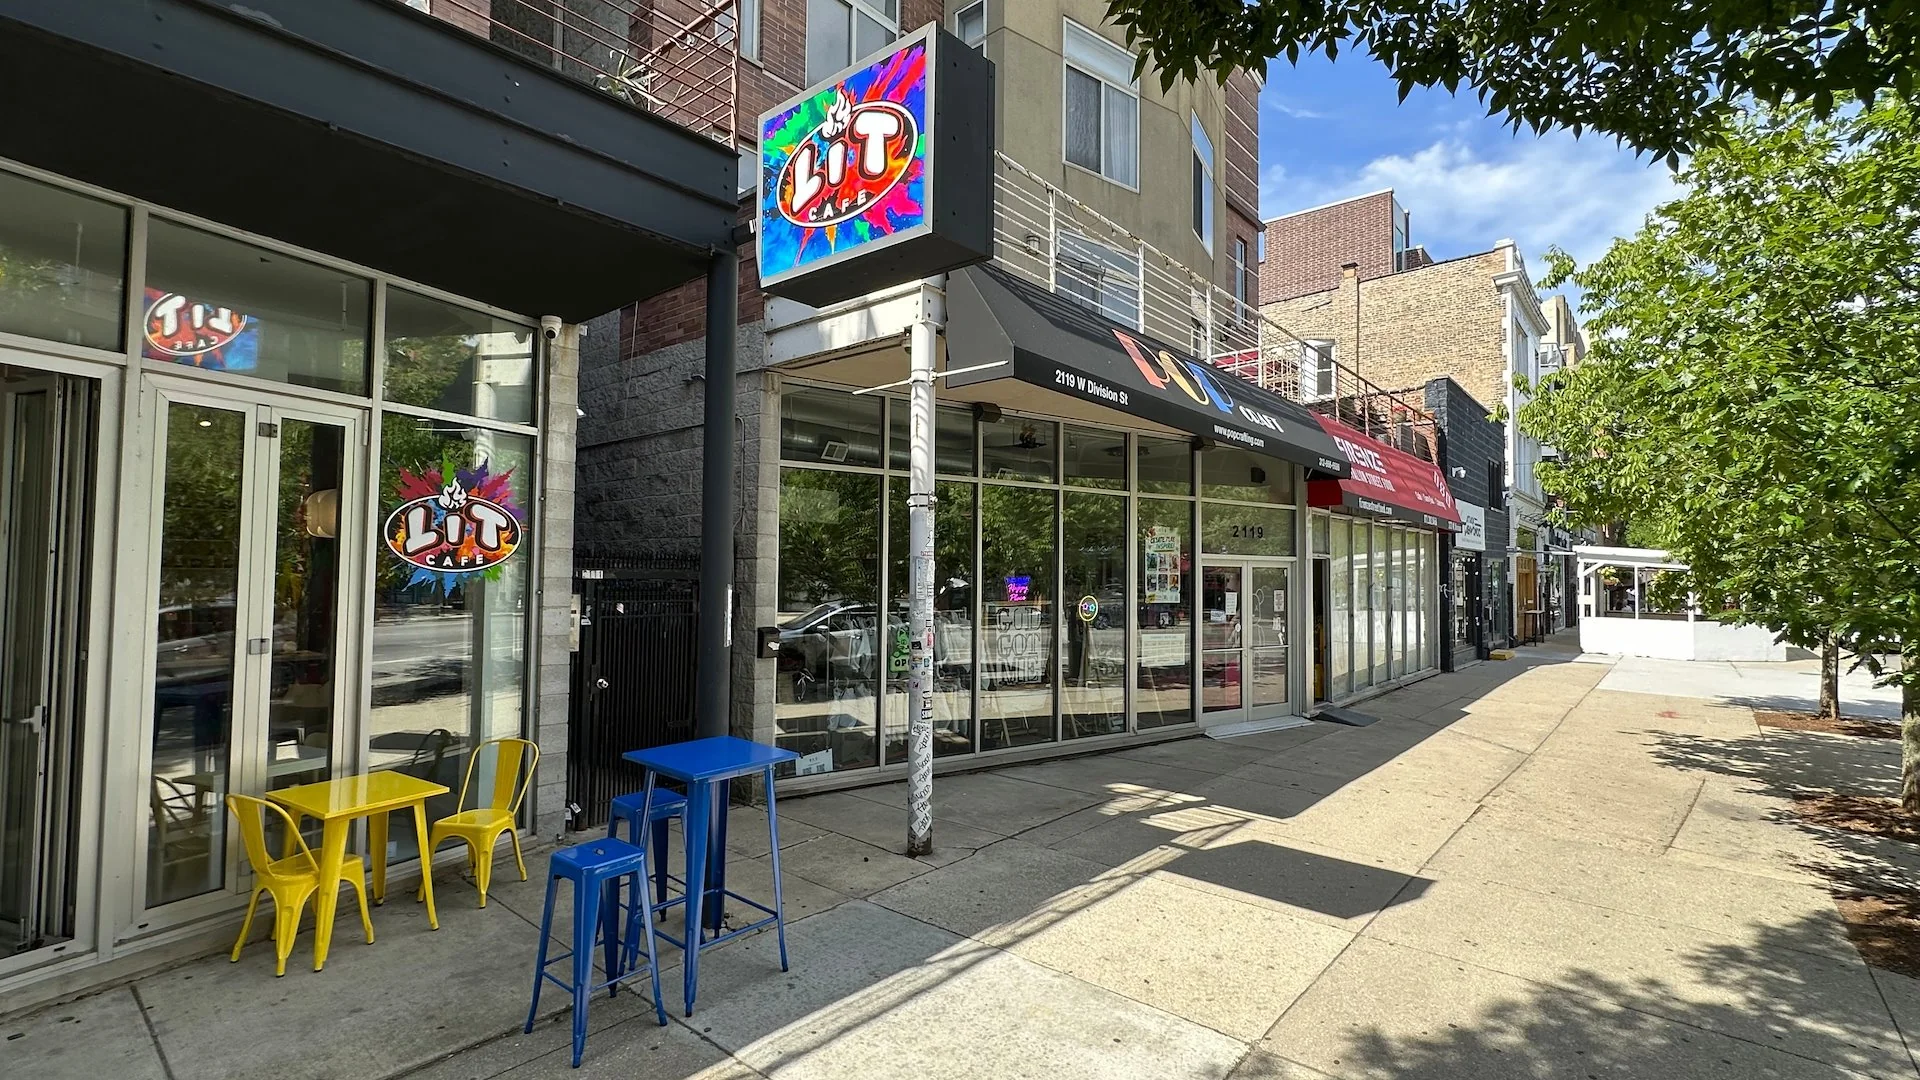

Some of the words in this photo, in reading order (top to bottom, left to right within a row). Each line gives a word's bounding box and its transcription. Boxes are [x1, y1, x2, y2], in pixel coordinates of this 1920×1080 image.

[807, 190, 868, 222] CAFE
[1055, 369, 1076, 388] 2119
[1076, 375, 1086, 391] W
[1087, 379, 1118, 403] Division
[1119, 390, 1129, 406] St
[1111, 328, 1235, 415] POP
[1332, 435, 1388, 475] FIRENZE
[1232, 525, 1264, 539] 2119
[425, 554, 485, 567] CAFE
